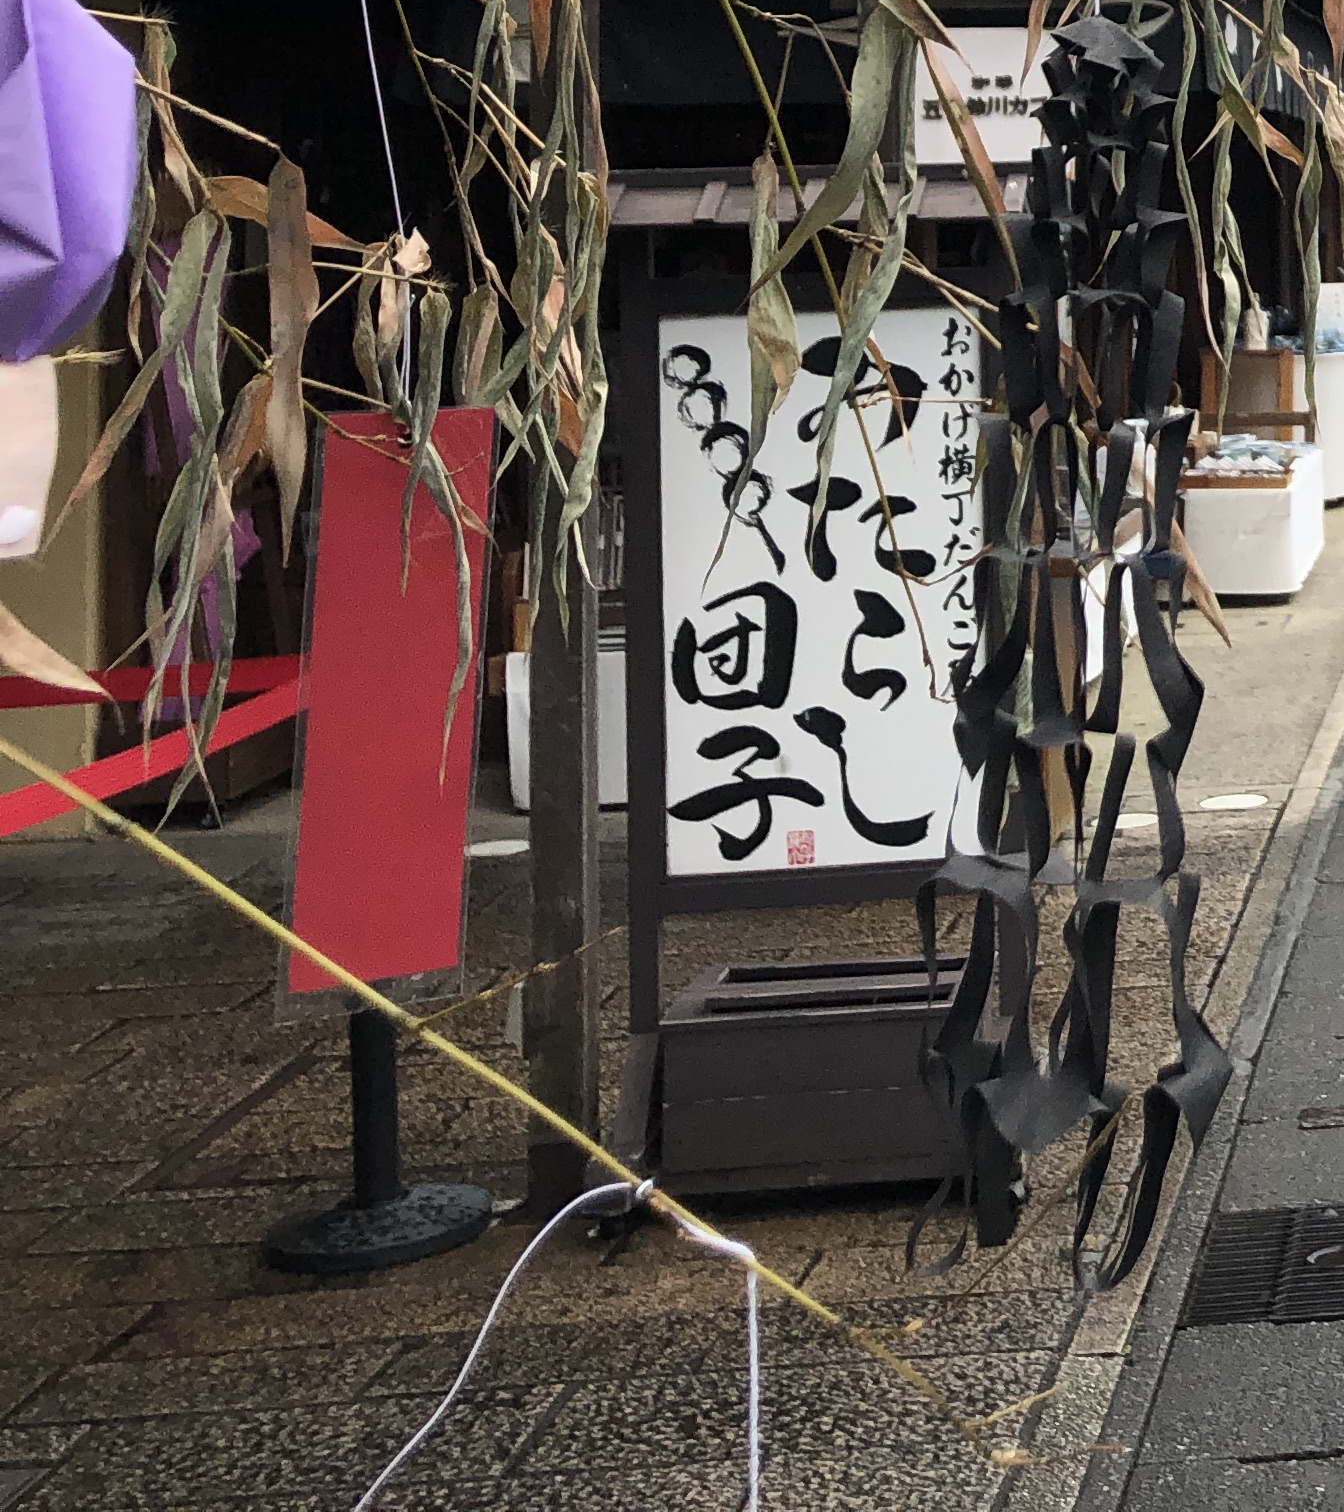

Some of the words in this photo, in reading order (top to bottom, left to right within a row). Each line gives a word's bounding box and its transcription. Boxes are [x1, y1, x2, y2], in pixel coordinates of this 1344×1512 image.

[667, 580, 825, 862] 団子
[786, 335, 936, 847] みたらし
